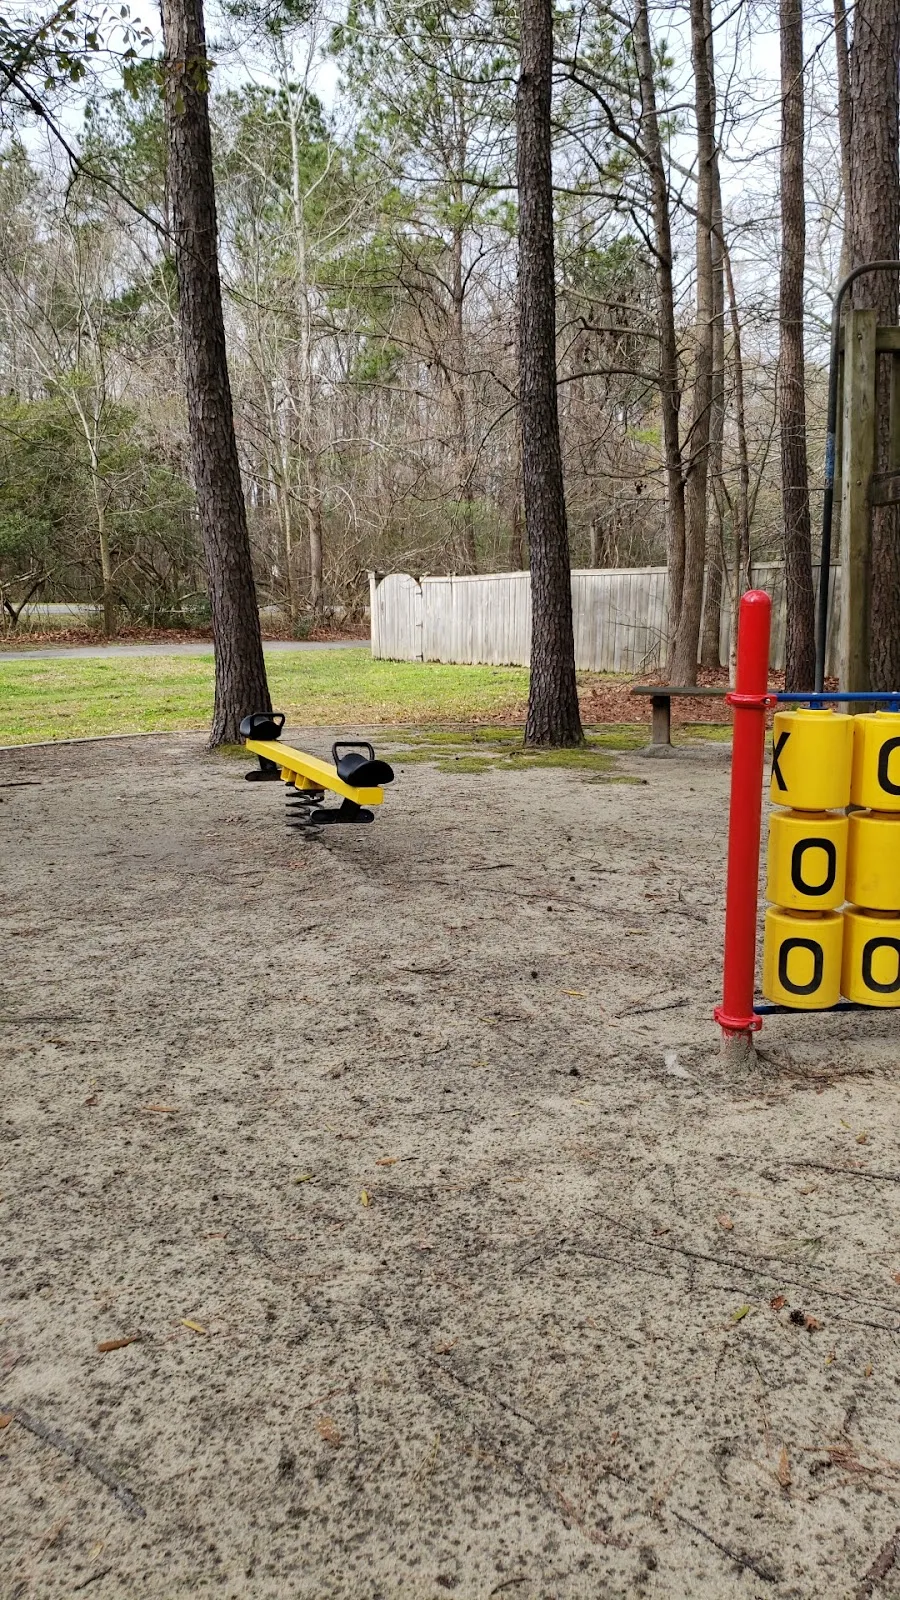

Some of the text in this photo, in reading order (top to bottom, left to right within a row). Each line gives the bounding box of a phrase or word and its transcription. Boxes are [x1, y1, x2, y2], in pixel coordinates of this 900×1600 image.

[791, 837, 836, 896] O
[778, 937, 824, 996] O
[861, 936, 900, 994] O
